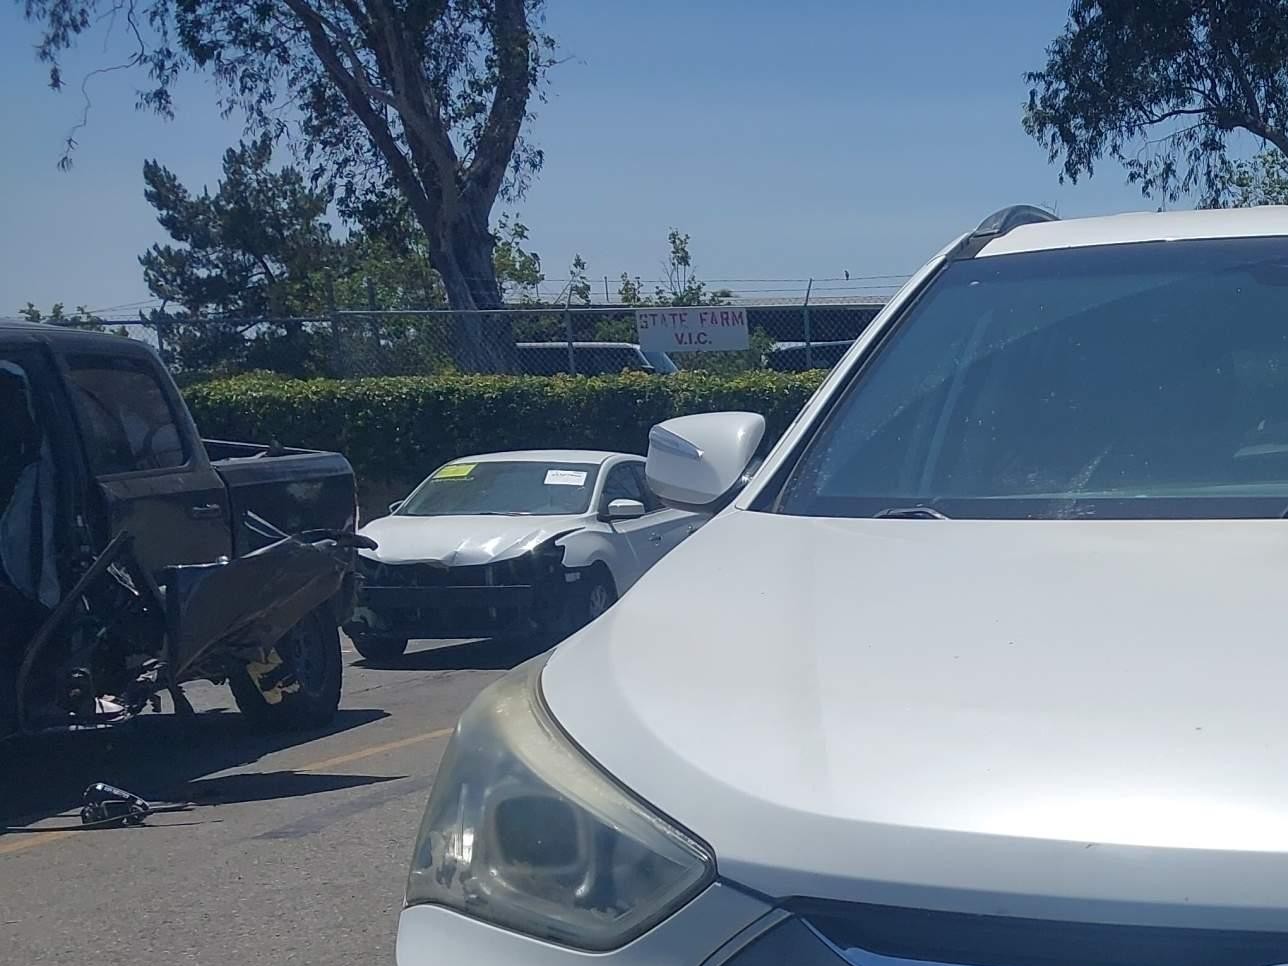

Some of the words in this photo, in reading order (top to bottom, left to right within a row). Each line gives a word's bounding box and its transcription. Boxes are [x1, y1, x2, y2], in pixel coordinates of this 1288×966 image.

[640, 313, 688, 328] STATE
[699, 311, 744, 327] FARM
[674, 331, 713, 345] V.I.C.
